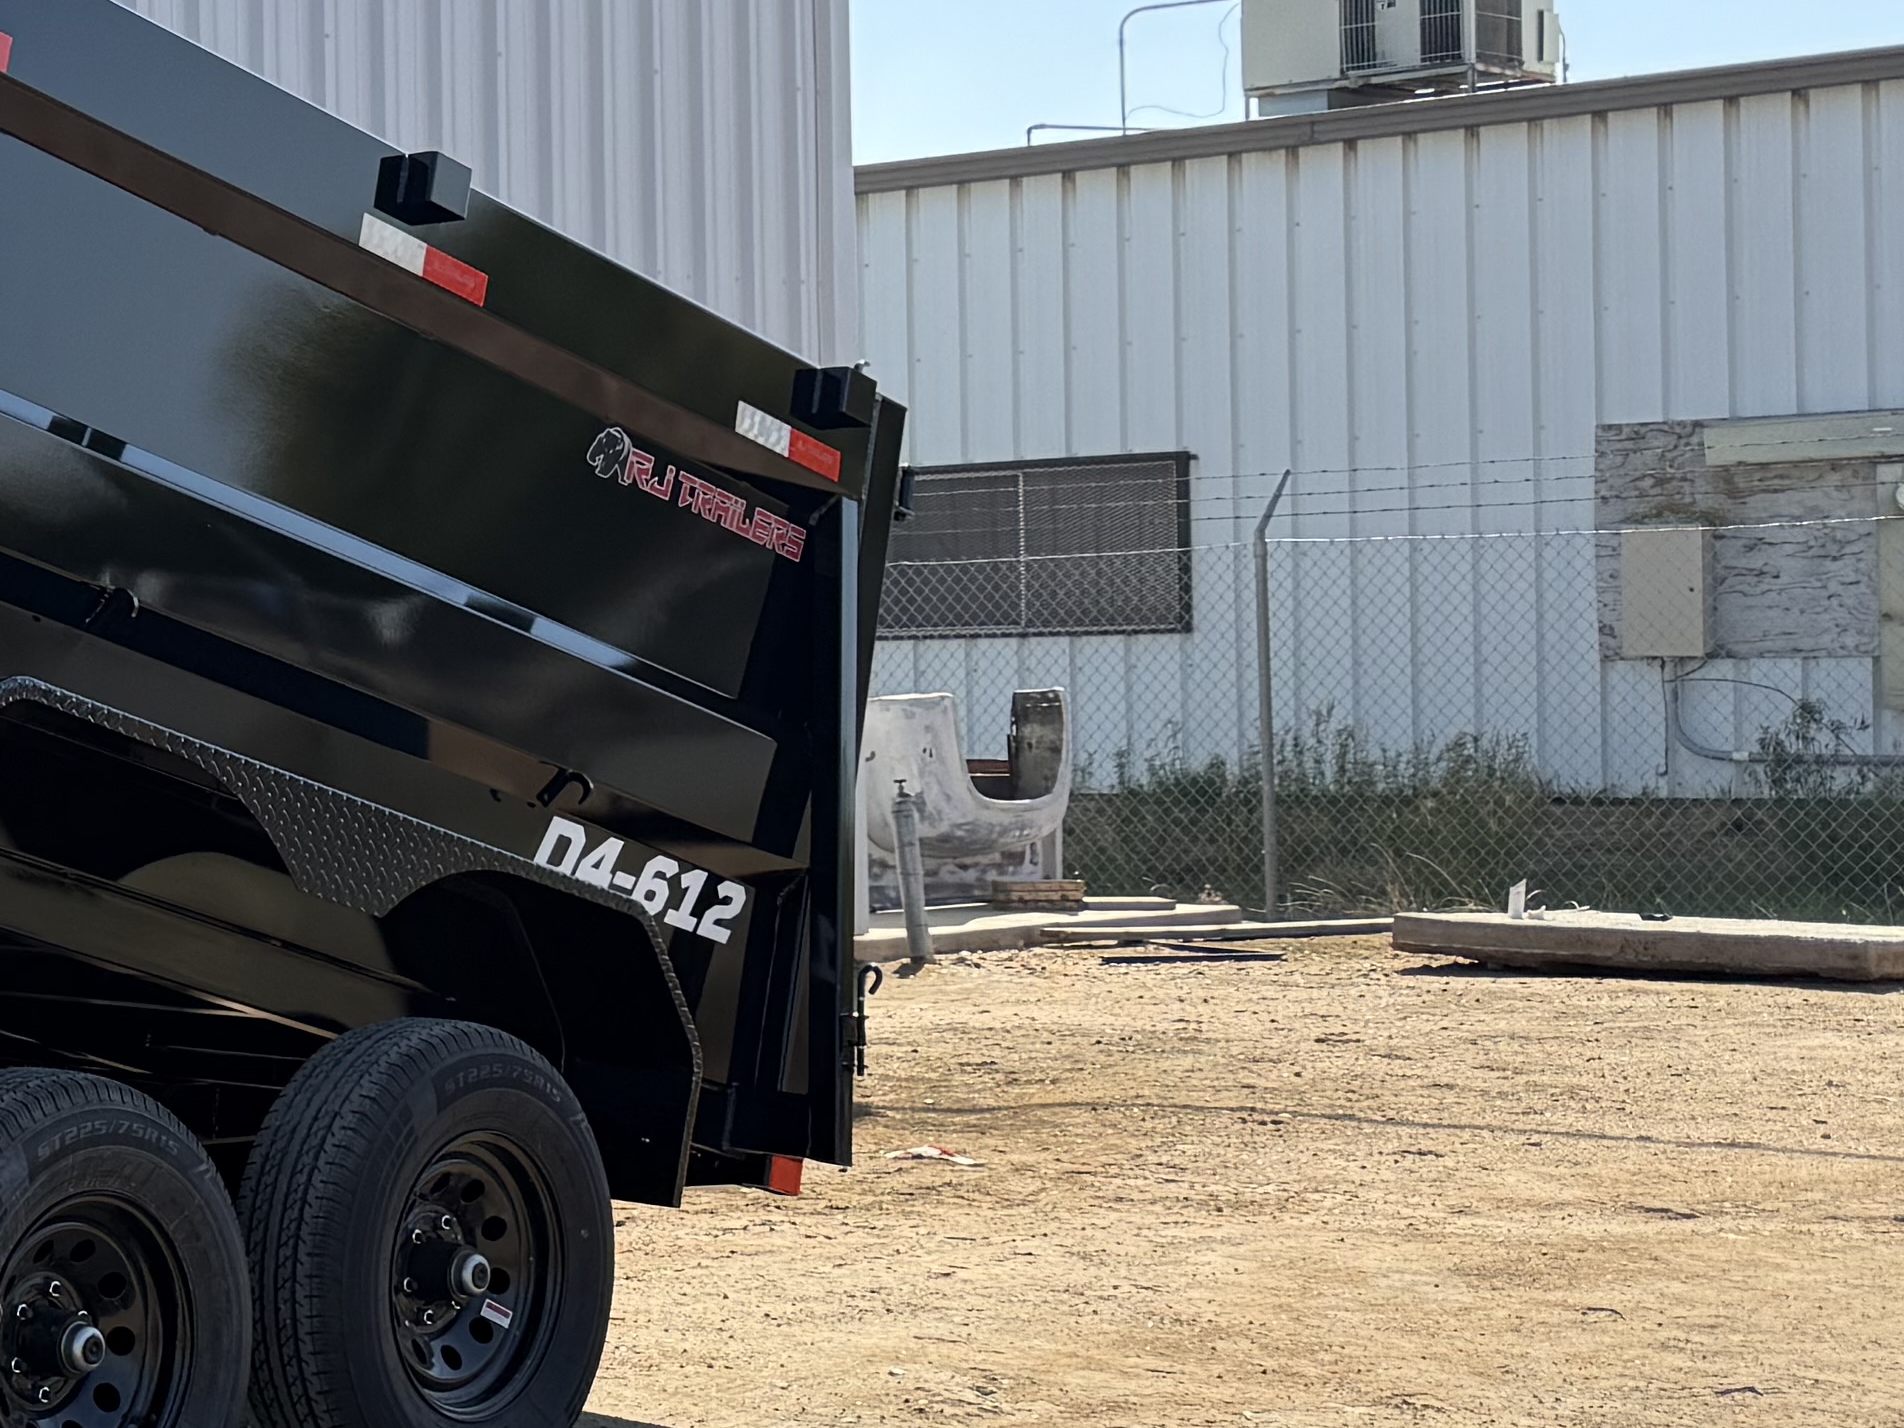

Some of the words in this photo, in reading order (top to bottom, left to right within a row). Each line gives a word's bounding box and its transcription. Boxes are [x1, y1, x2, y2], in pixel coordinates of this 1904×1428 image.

[624, 447, 676, 501] RJ
[678, 470, 807, 563] TRAILERS
[533, 815, 747, 945] D4-612
